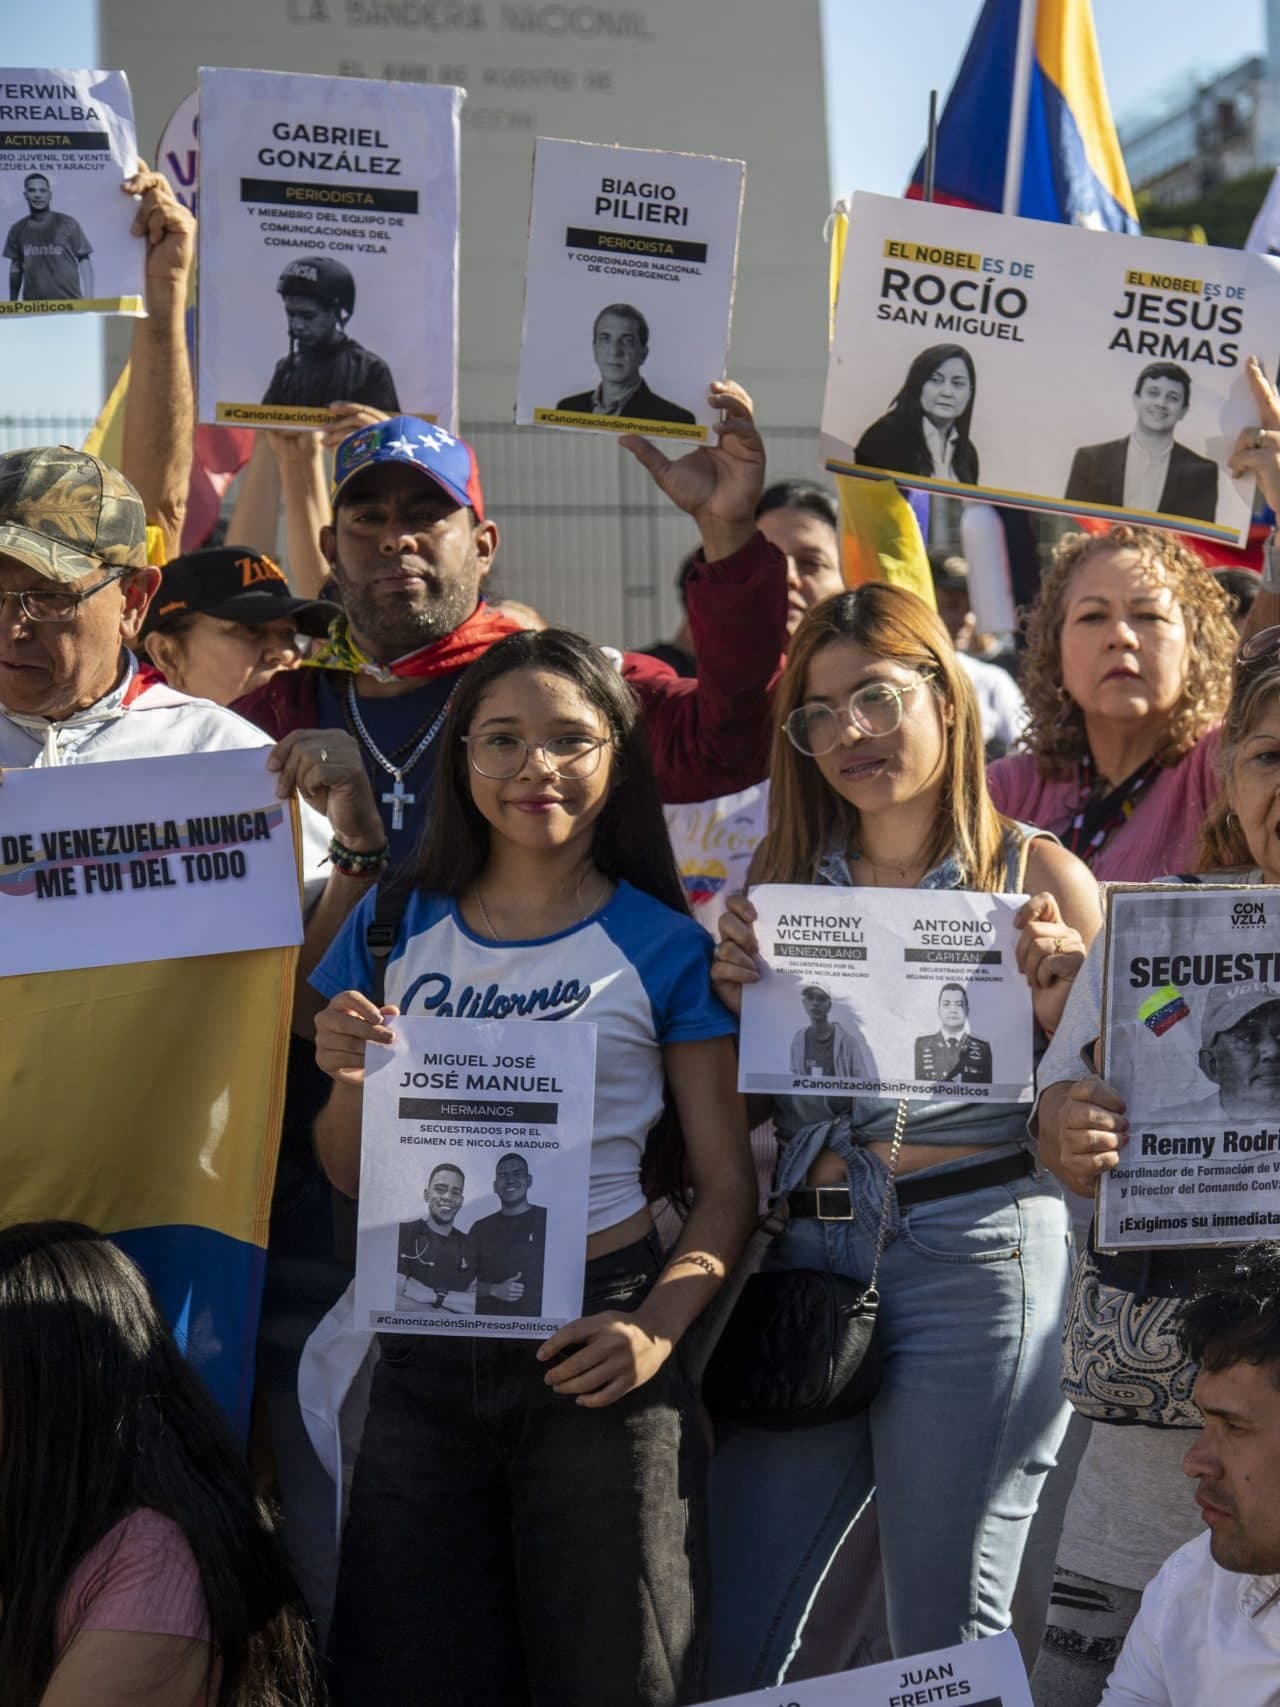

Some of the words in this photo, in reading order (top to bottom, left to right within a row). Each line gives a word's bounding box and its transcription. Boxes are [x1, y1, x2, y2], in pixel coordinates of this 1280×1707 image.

[5, 136, 71, 145] ACTIVISTA
[273, 122, 389, 149] GABRIEL
[258, 148, 401, 175] GONZÁLEZ
[285, 187, 375, 205] PERIODISTA
[601, 178, 676, 201] BIAGIO
[247, 207, 254, 216] Y
[258, 208, 313, 220] MIEMBRO
[316, 211, 338, 222] DEL
[342, 214, 385, 225] EQUIPO
[388, 217, 404, 227] DE
[595, 196, 689, 226] PILIERI
[260, 222, 365, 239] COMUNICACIONES
[369, 229, 391, 240] DEL
[264, 237, 325, 250] COMANDO
[328, 241, 353, 252] CON
[357, 243, 387, 254] VZLA
[598, 235, 674, 254] PERIODISTA
[567, 252, 575, 260] Y
[576, 253, 649, 268] COORDINADOR
[651, 262, 703, 275] NACIONAL
[888, 241, 909, 259] EL
[915, 246, 977, 270] NOBEL
[981, 257, 1004, 275] ES
[1009, 261, 1035, 279] DE
[587, 264, 601, 273] DE
[603, 265, 680, 282] CONVERGENCIA
[880, 267, 1029, 320] ROCÍO
[1127, 272, 1146, 287] EL
[1150, 275, 1200, 295] NOBEL
[1203, 282, 1221, 298] ES
[1224, 284, 1246, 300] DE
[877, 303, 928, 327] SAN
[934, 313, 1025, 343] MIGUEL
[1113, 290, 1245, 336] JESÚS
[1108, 326, 1240, 368] ARMAS
[2, 834, 34, 865] DE
[41, 820, 180, 862] VENEZUELA
[186, 812, 271, 847] NUNCA
[36, 867, 77, 899] ME
[84, 864, 122, 894] FUI
[131, 857, 176, 889] DEL
[181, 850, 247, 883] TODO
[1233, 903, 1264, 914] CON
[778, 914, 862, 929] ANTHONY
[913, 919, 992, 933] ANTONIO
[1231, 914, 1266, 925] VZLA
[776, 929, 864, 943] VICENTELLI
[921, 934, 985, 946] SEQUEA
[780, 945, 861, 958] VENEZOLANO
[400, 973, 591, 1018] California
[423, 1053, 488, 1068] MIGUEL
[492, 1054, 535, 1069] JOSÉ
[399, 1070, 458, 1089] JOSÉ
[466, 1074, 563, 1093] MANUEL
[440, 1104, 514, 1117] HERMANOS
[420, 1124, 502, 1135] SECUESTRADOS
[504, 1127, 526, 1136] POR
[529, 1127, 541, 1136] EL
[400, 1135, 447, 1146] RÉGIMEN
[449, 1138, 464, 1147] DE
[514, 1139, 560, 1150] MADURO
[1141, 1132, 1216, 1158] Renny
[1110, 1167, 1177, 1179] Coordinador
[1181, 1166, 1194, 1177] de
[1198, 1162, 1254, 1176] Formación
[1257, 1163, 1270, 1173] de
[1121, 1188, 1127, 1198] y
[1131, 1185, 1175, 1196] Director
[1178, 1184, 1195, 1194] del
[1198, 1181, 1248, 1193] Comando
[1120, 1216, 1187, 1234] ¡Exigimos
[1191, 1217, 1208, 1228] su
[1212, 1211, 1280, 1227] inmediata
[899, 1663, 954, 1688] JUAN
[889, 1680, 972, 1707] FREITES
